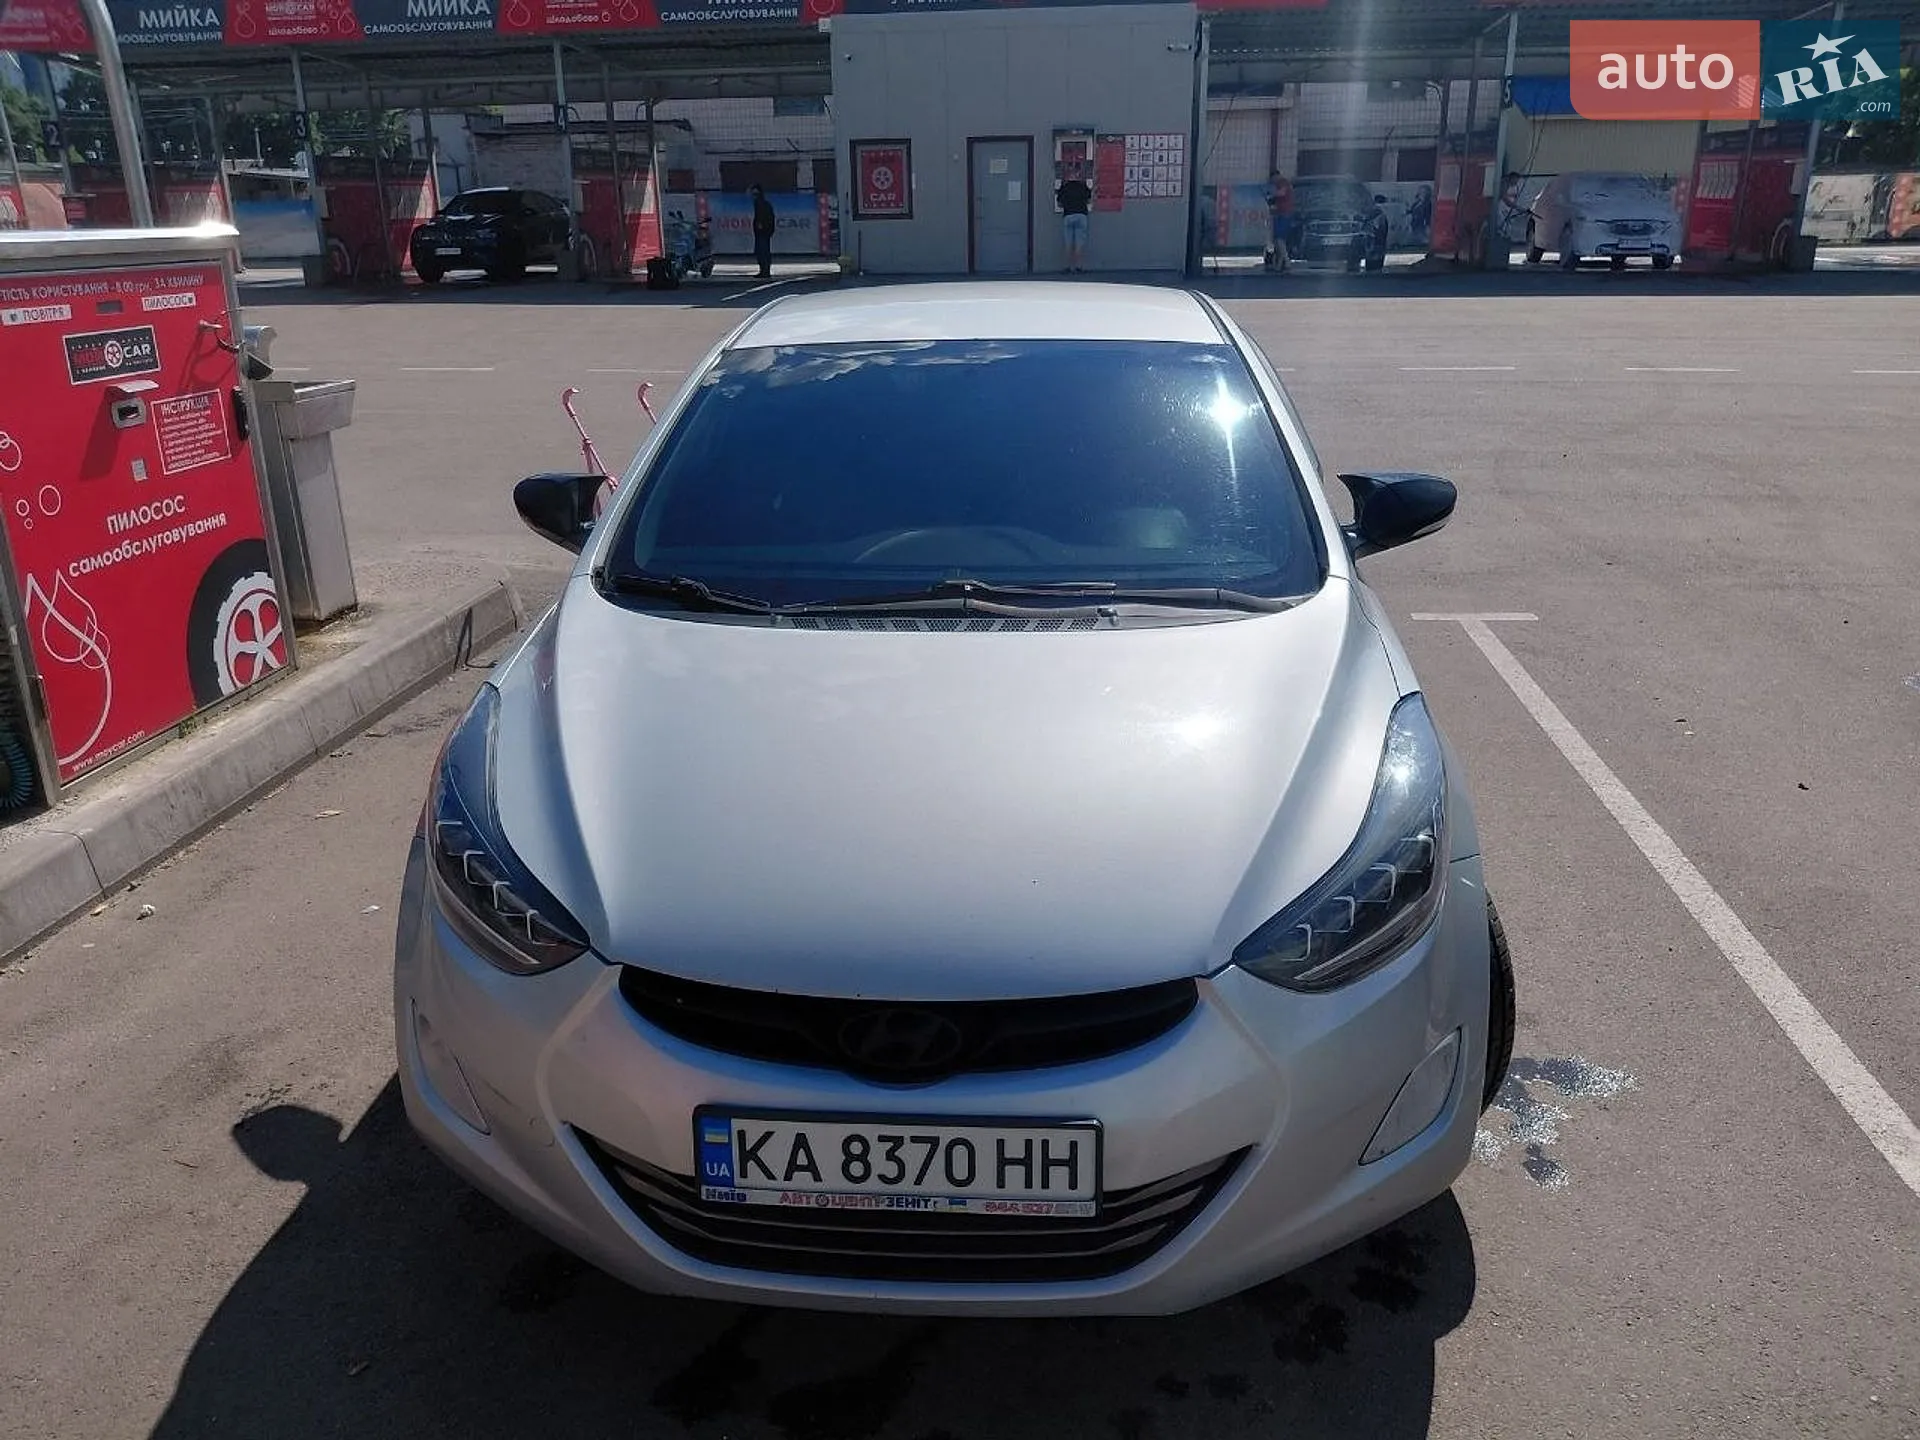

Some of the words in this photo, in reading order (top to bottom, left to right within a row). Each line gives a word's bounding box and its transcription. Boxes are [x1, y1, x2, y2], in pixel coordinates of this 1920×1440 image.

[139, 4, 220, 29] МИЙКА
[660, 7, 798, 22] САМООБСЛУГОВУВАННЯ
[363, 20, 494, 35] САМООБСЛУГОВУВАННЯ
[46, 123, 61, 146] 2
[296, 114, 306, 137] 3
[31, 281, 110, 300] КОРИСТУВАННЯ
[144, 294, 189, 310] ПИЛОСОС
[23, 306, 65, 322] ПОВІТРЯ
[123, 343, 152, 358] CAR
[107, 495, 186, 535] ПИЛОСОС
[68, 512, 228, 578] самообслуговування
[705, 1162, 731, 1178] UA
[840, 1133, 977, 1188] 8370
